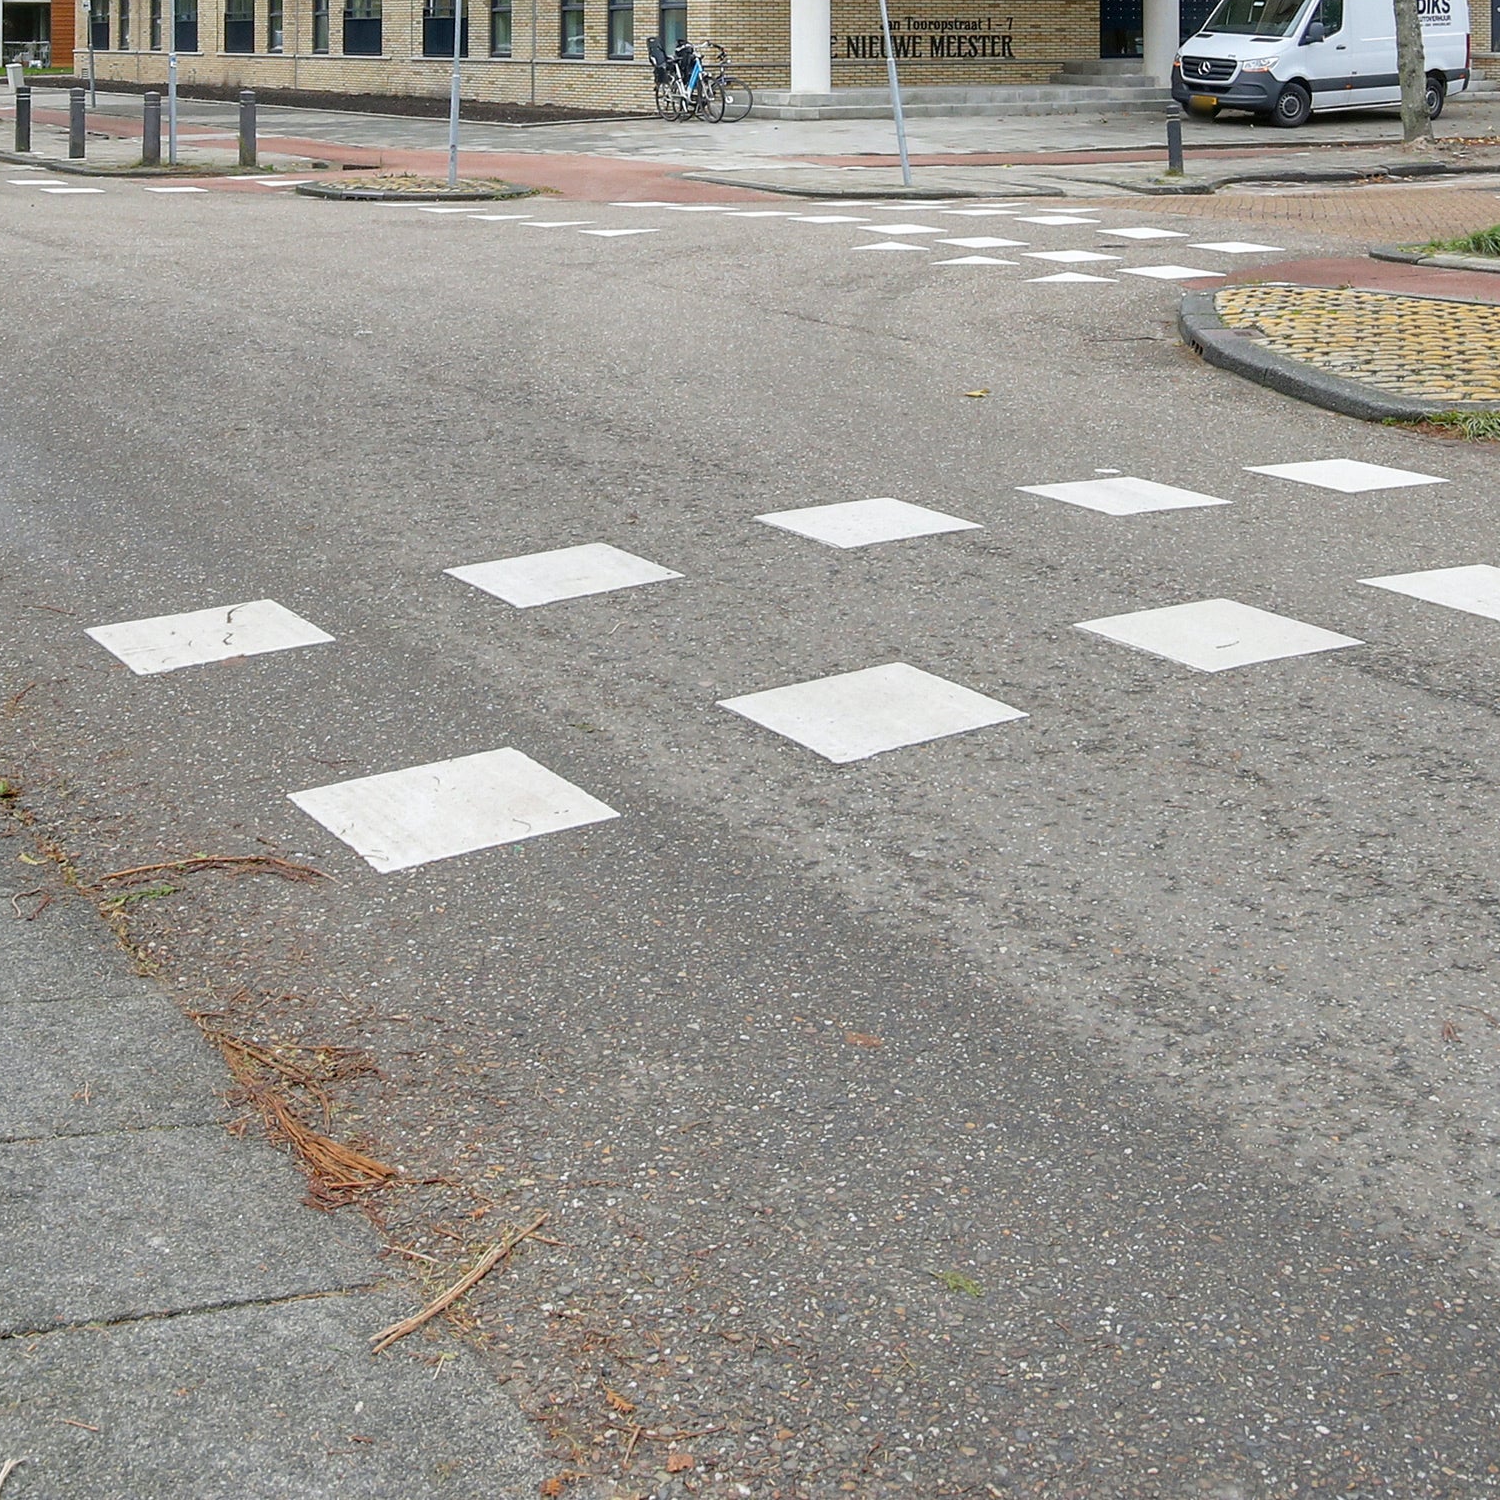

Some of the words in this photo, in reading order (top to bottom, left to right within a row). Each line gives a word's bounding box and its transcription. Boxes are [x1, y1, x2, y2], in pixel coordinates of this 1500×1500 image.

[905, 17, 982, 33] Tooropstraat
[1007, 17, 1014, 30] 7
[930, 35, 1016, 58] MEESTER
